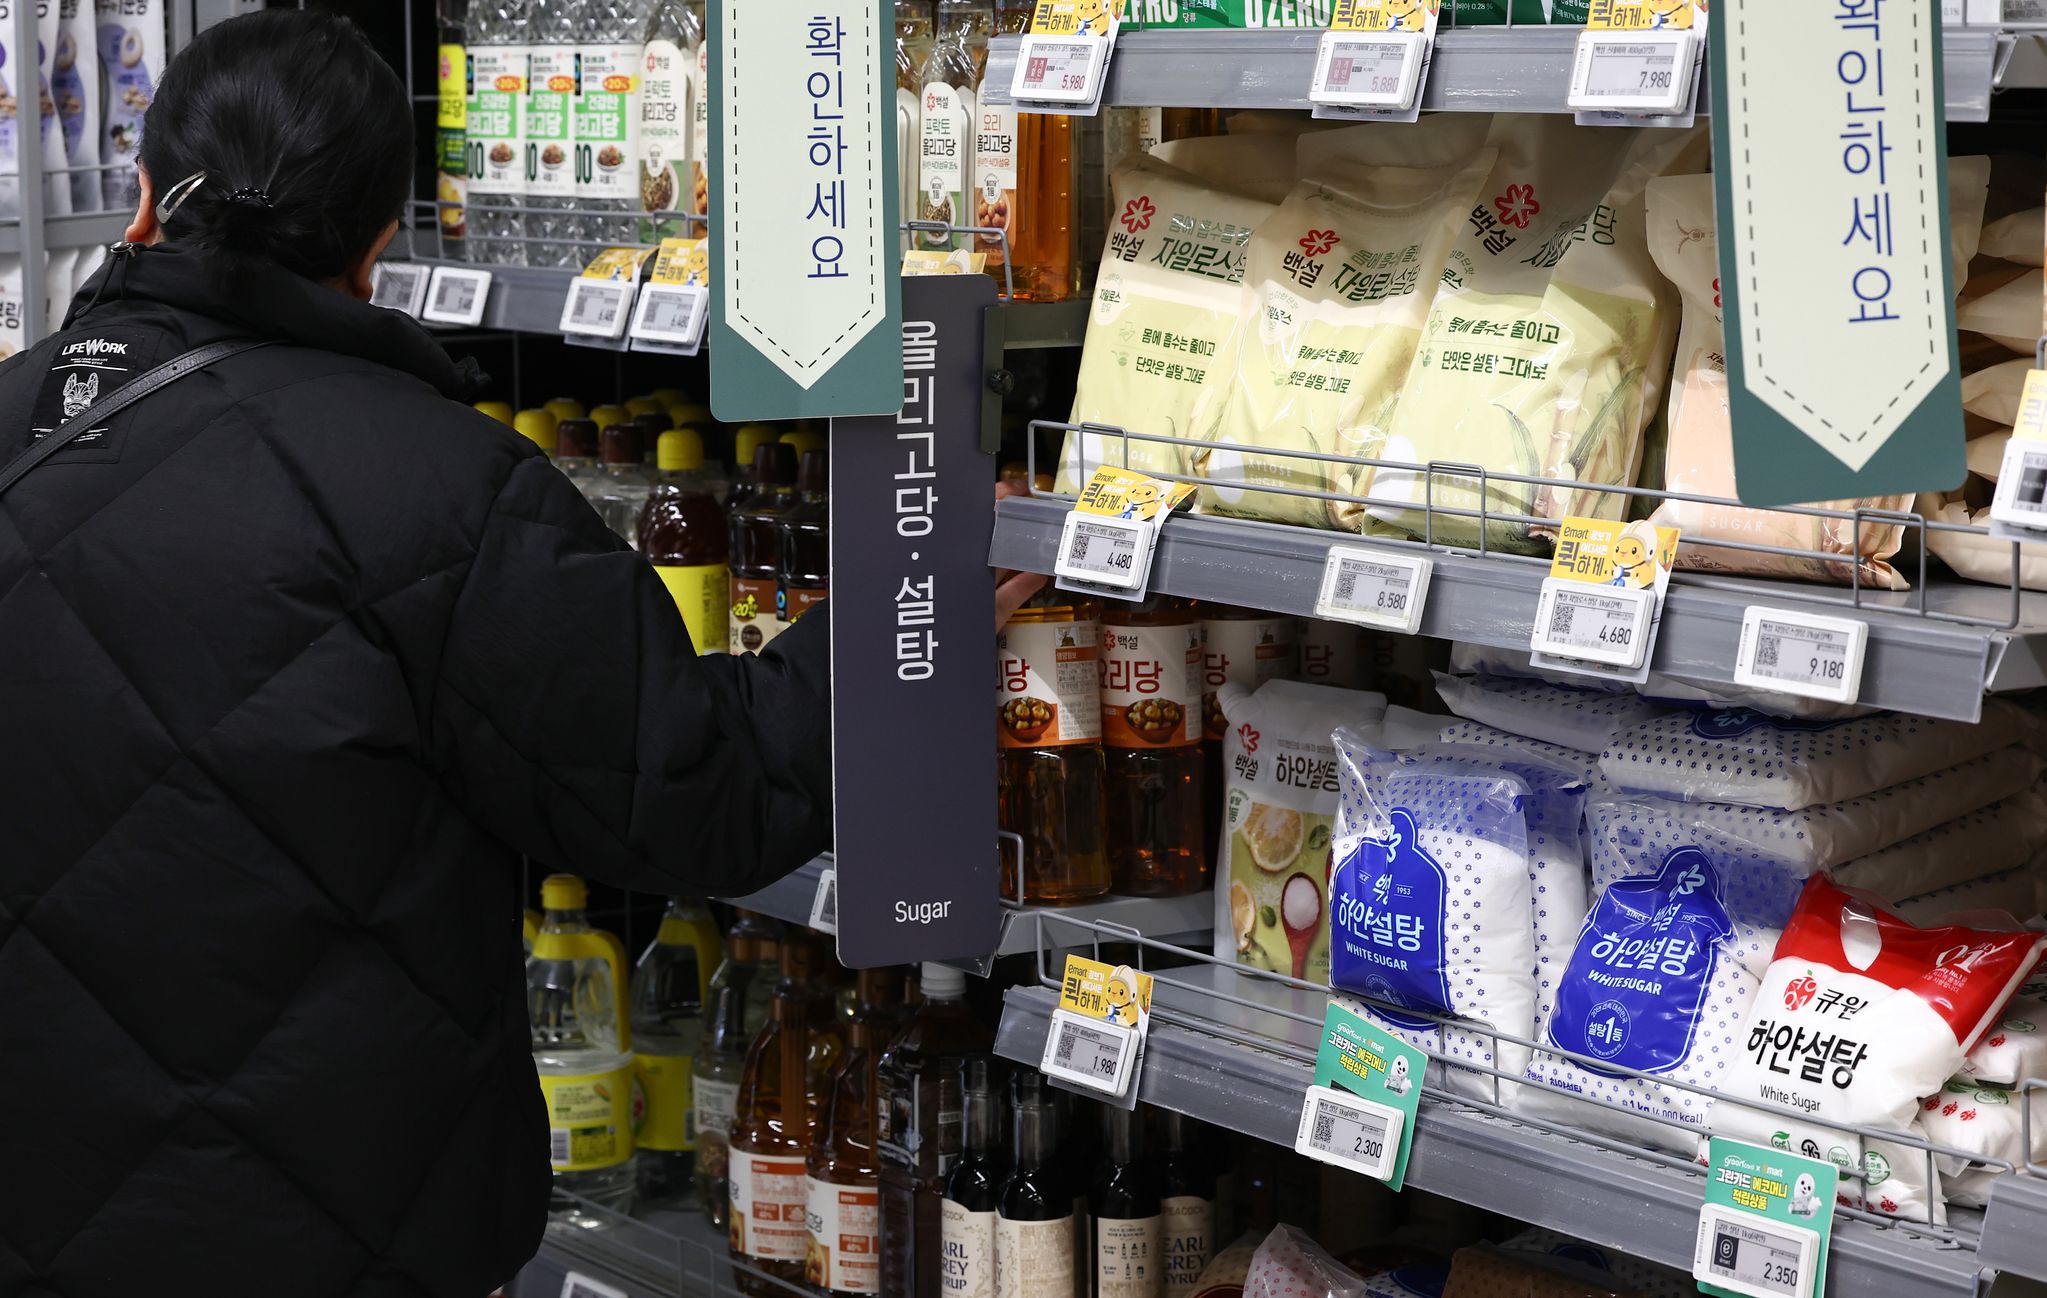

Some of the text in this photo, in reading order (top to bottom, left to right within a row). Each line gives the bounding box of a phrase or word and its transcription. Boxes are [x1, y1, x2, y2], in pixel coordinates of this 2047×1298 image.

[1640, 71, 1672, 89] 7,980
[926, 118, 951, 135] 프락토
[983, 114, 1001, 131] 요리
[805, 16, 849, 279] 확인하세요
[923, 138, 956, 156] 올리고당
[978, 134, 1012, 153] 올리고당
[1469, 204, 1517, 256] 백설
[1110, 232, 1145, 263] 백설
[1282, 251, 1324, 289] 백설
[1448, 316, 1560, 344] 몸에 흡수는 줄이고
[62, 339, 128, 356] LIFEWORK
[1141, 328, 1216, 357] 몸에 흡수는 줄이고
[1337, 350, 1363, 366] 줄이고
[1441, 350, 1472, 372] 단맛은
[1473, 353, 1499, 375] 설탕
[1135, 356, 1206, 384] 단맛은 설탕 그대로
[1306, 374, 1325, 391] 설탕
[1564, 526, 1588, 539] emart
[1709, 517, 1763, 532] SUGAR
[1107, 552, 1133, 570] 4,480
[1377, 591, 1407, 610] 8,580
[1117, 636, 1139, 650] 백설
[1599, 625, 1632, 645] 4,680
[1810, 658, 1844, 680] 9,180
[1234, 754, 1258, 781] 백설
[1396, 887, 1411, 896] 1953
[895, 900, 951, 924] Sugar
[1338, 892, 1425, 952] 하얀설탕
[1625, 909, 1646, 922] SINCE
[1591, 931, 1696, 976] 하얀설탕
[1068, 964, 1087, 977] emart
[1813, 987, 1869, 1021] 큐원
[1328, 1031, 1388, 1074] 그린카드 에코머니
[1747, 1019, 1868, 1090] 하얀설탕
[1093, 1056, 1117, 1076] 1,980
[1339, 1054, 1369, 1080] 적립상품
[1759, 1084, 1821, 1113] White Sugar
[1354, 1137, 1383, 1159] 2,300
[1715, 1167, 1789, 1198] 그린카드 에코머니
[1732, 1188, 1768, 1211] 적립상품
[1764, 1262, 1798, 1287] 2,350
